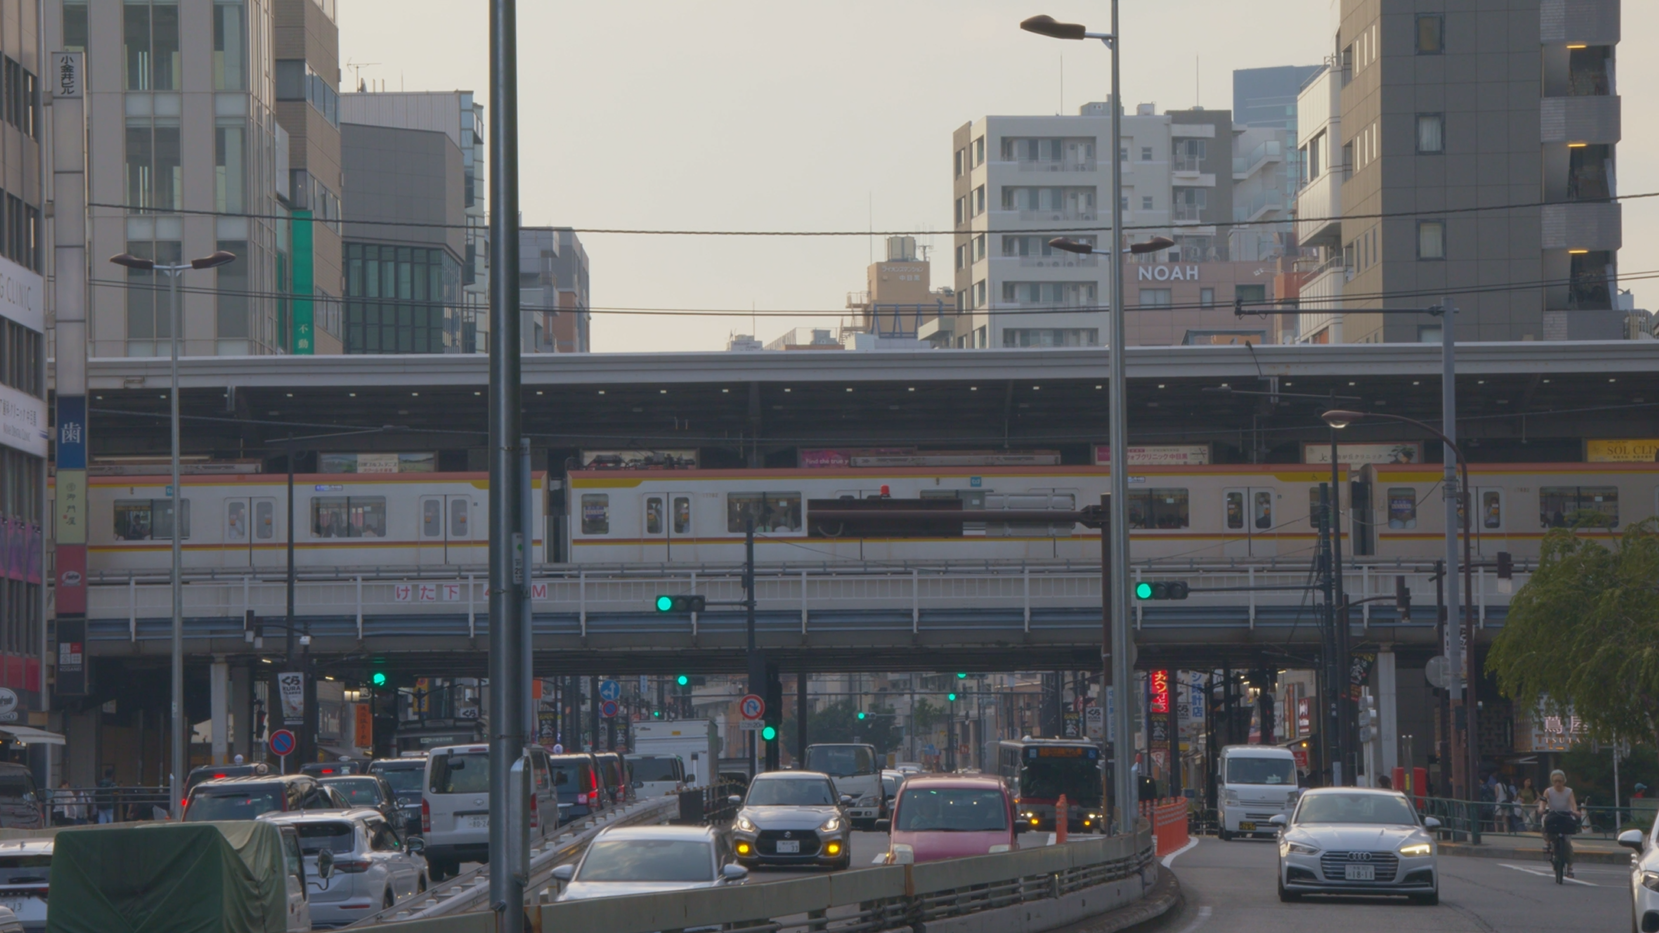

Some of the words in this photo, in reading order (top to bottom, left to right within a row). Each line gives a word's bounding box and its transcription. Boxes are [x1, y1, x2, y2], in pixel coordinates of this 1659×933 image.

[60, 55, 75, 95] 小金井ビル
[1138, 265, 1199, 281] NOAH
[7, 276, 31, 312] CLINIC
[61, 421, 82, 444] 歯
[1607, 446, 1631, 455] SOL
[396, 585, 460, 600] けた下
[282, 676, 300, 685] くら
